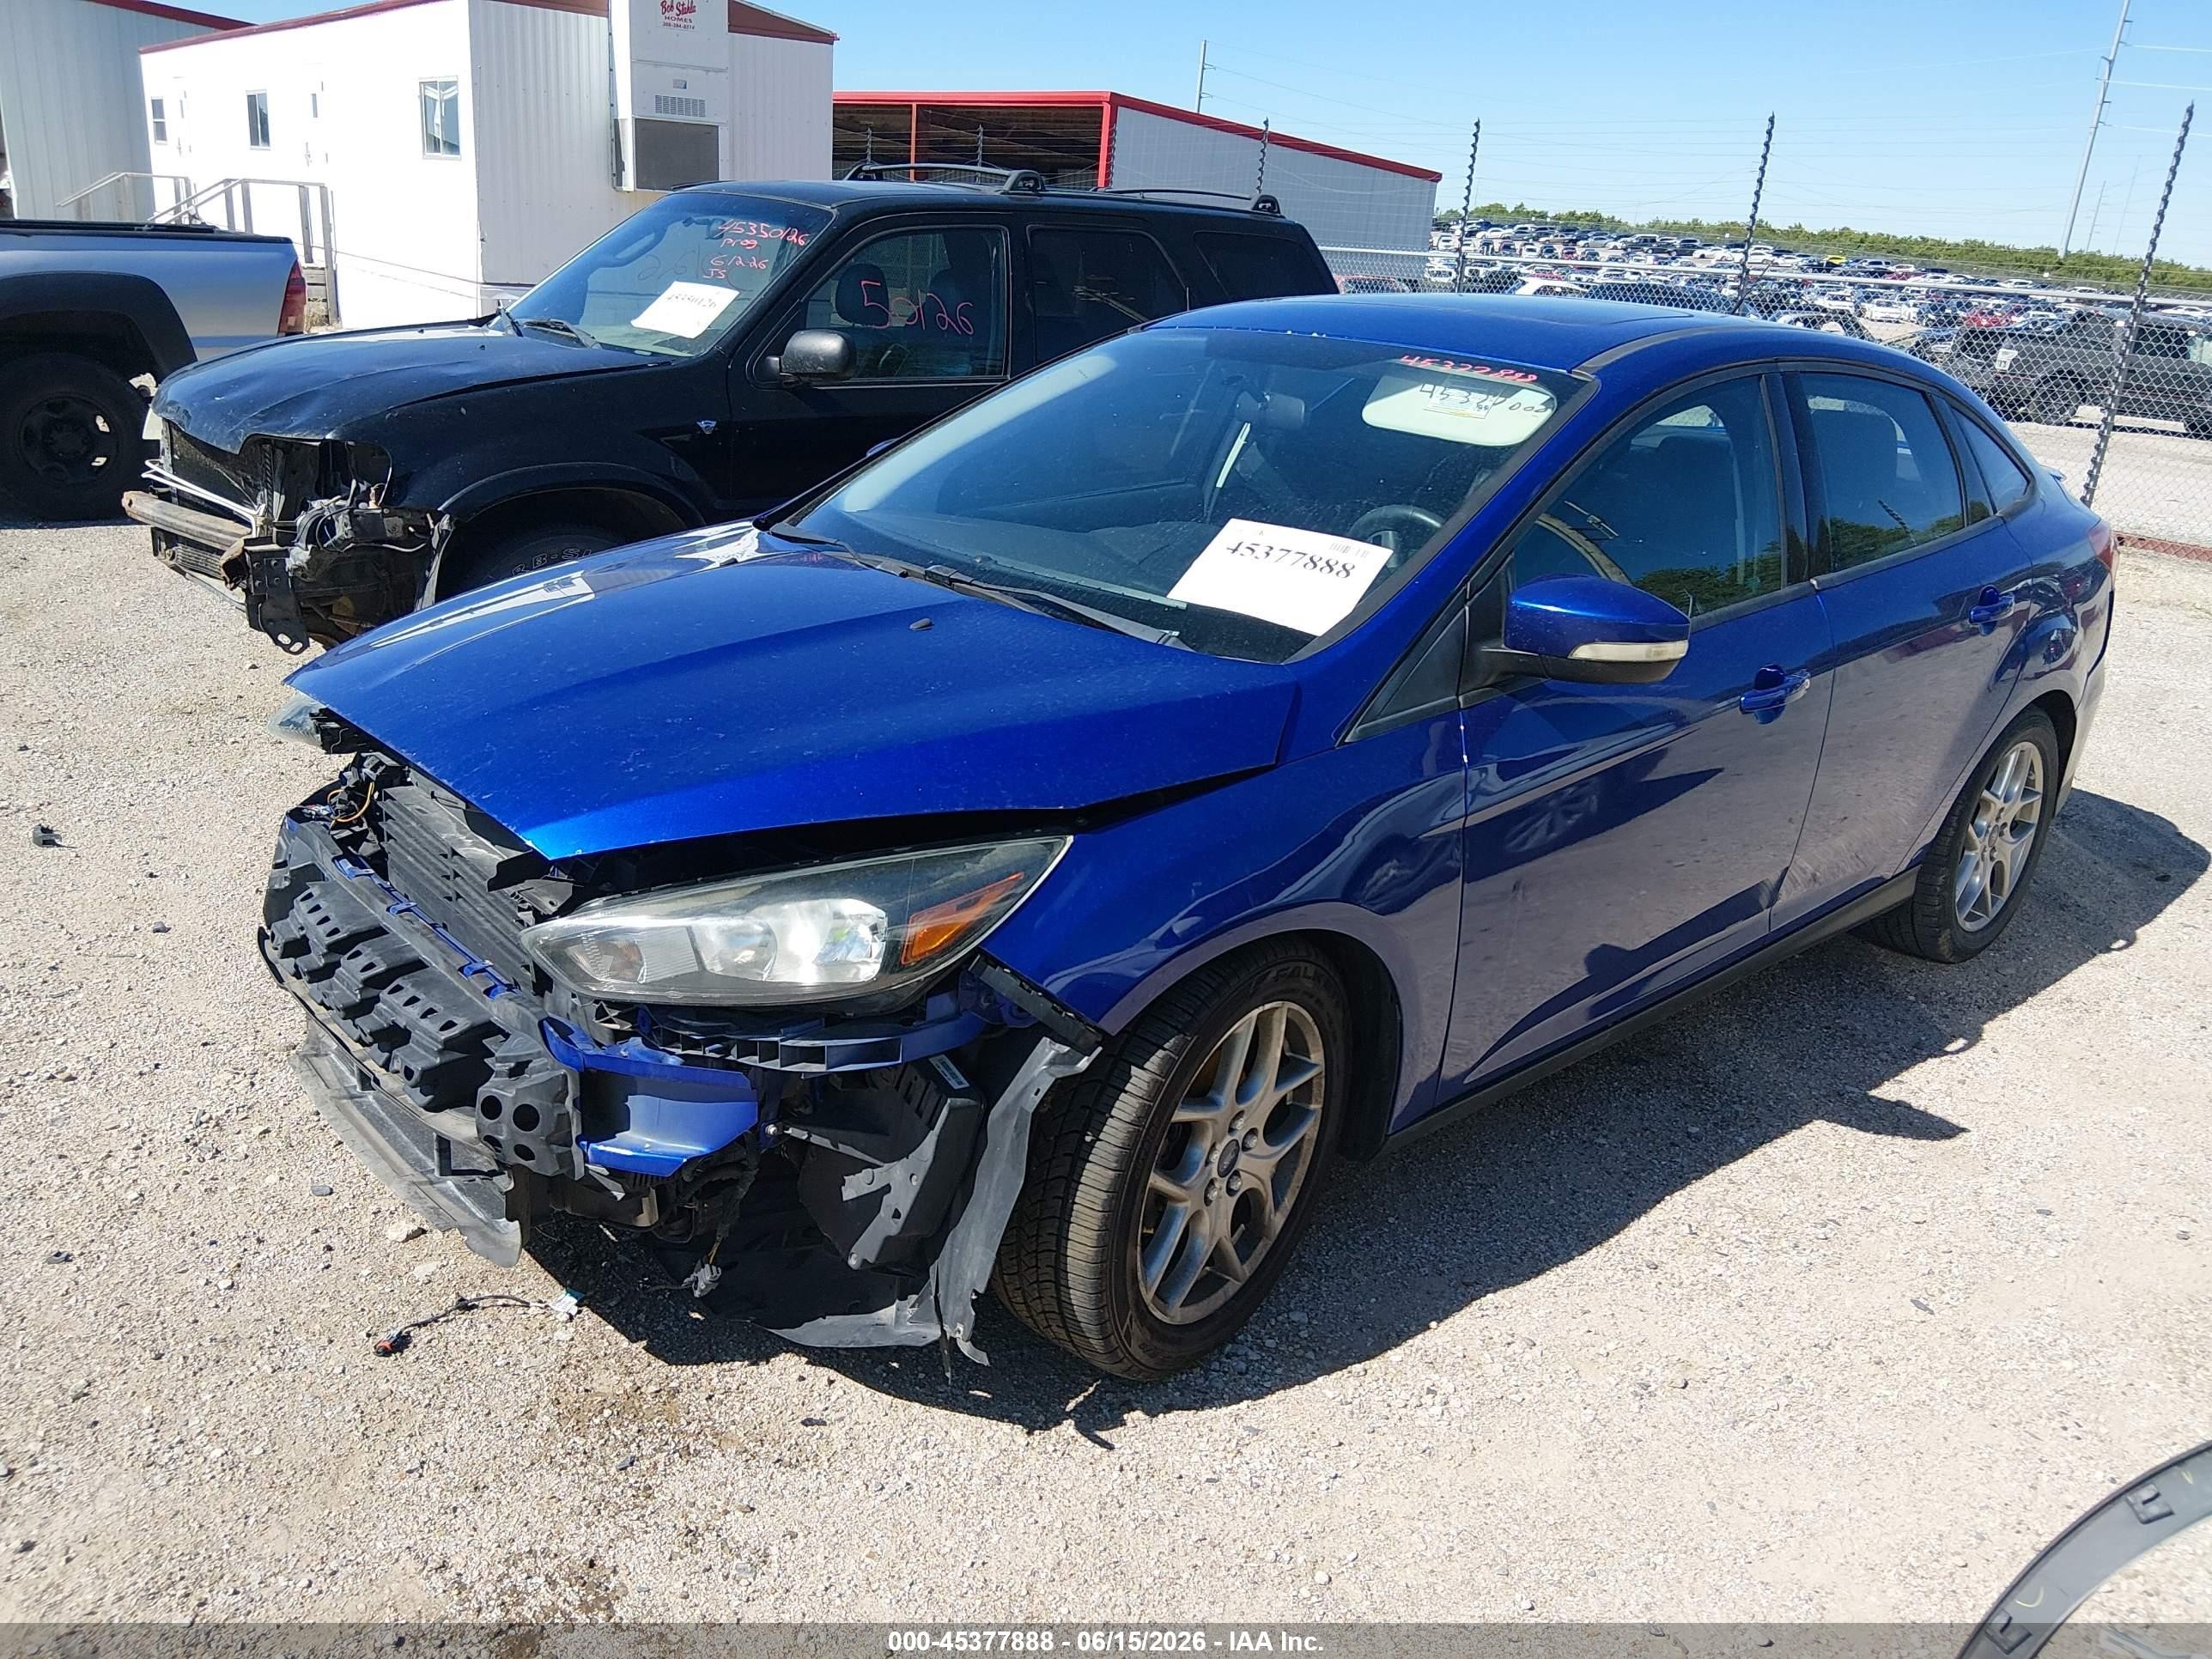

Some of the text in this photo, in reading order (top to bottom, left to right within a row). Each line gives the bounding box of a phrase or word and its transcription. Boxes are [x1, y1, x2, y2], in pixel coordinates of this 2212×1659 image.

[660, 0, 674, 15] Bob
[861, 280, 975, 335] 50126
[1226, 541, 1355, 579] 45377888
